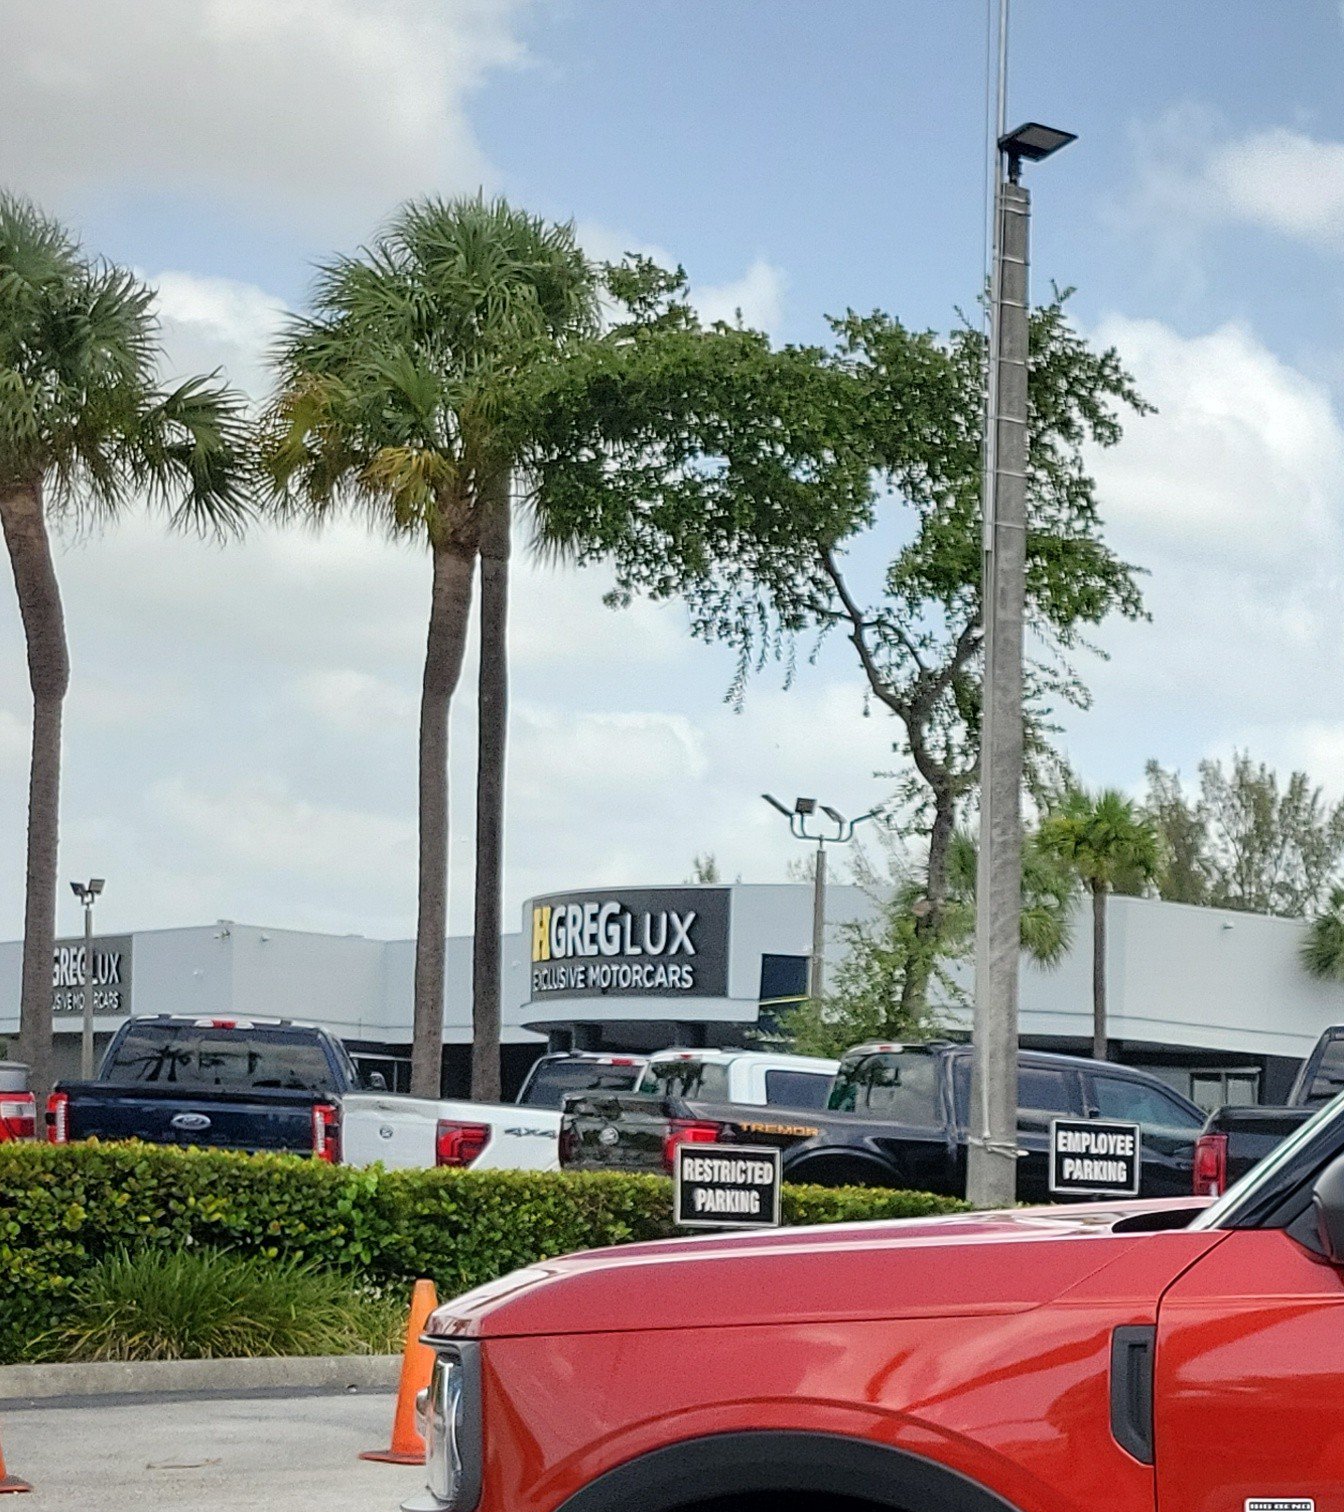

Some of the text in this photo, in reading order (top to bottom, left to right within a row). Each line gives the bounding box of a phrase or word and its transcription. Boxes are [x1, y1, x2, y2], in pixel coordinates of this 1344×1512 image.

[533, 963, 694, 992] EXCLUSIVE MOTORCARS
[739, 1122, 820, 1137] TREMOR
[1057, 1130, 1134, 1157] EMPLOYEE
[683, 1157, 773, 1185] RESTRICTED
[1062, 1158, 1127, 1183] PARKING
[694, 1187, 760, 1214] PARKING
